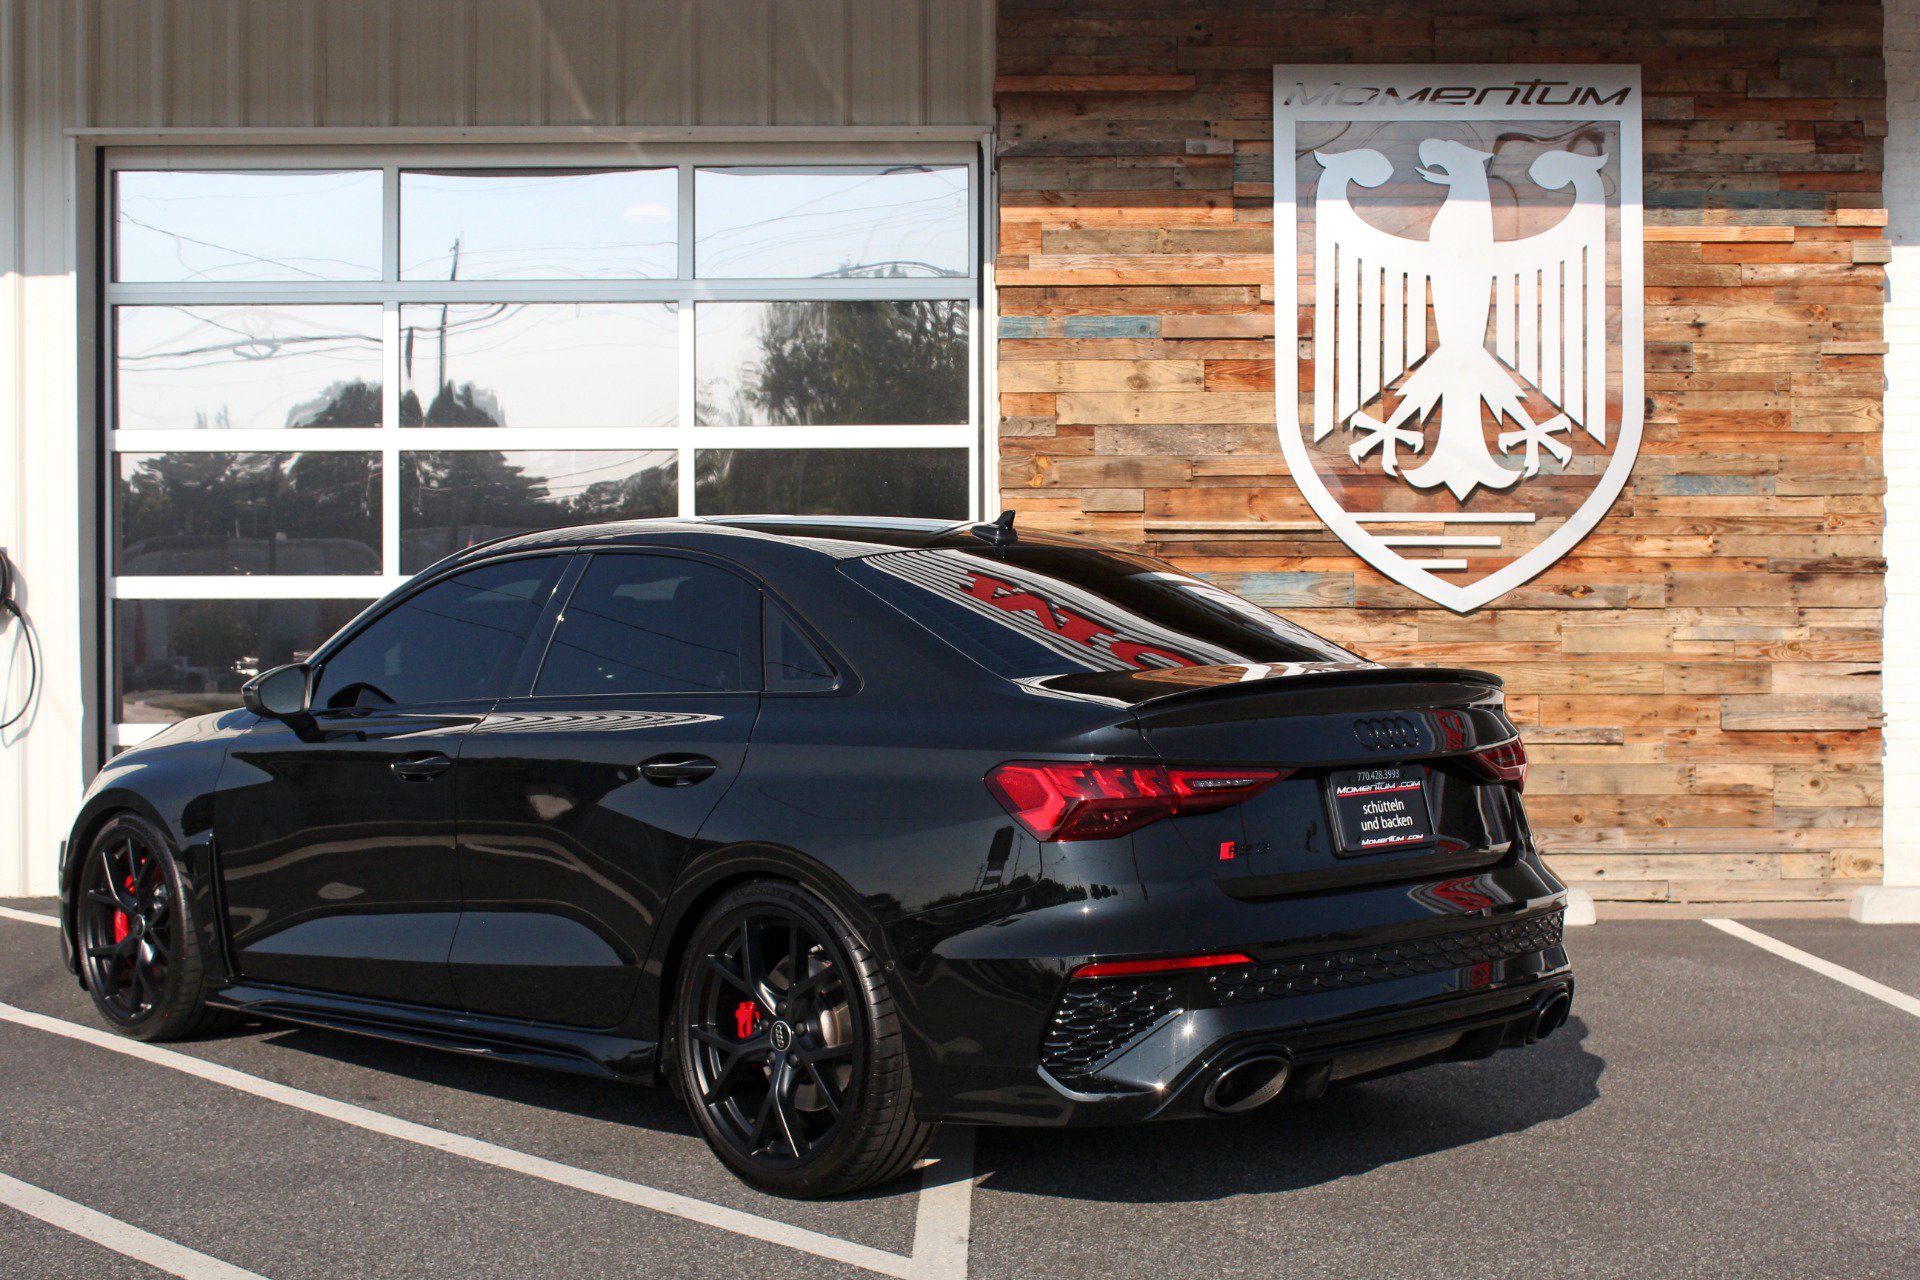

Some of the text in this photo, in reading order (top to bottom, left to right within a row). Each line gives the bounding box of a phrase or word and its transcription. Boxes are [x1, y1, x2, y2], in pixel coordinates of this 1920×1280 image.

[1357, 769, 1400, 781] 770.428.3993
[1362, 798, 1405, 815] schütteln
[1361, 814, 1413, 831] und backen
